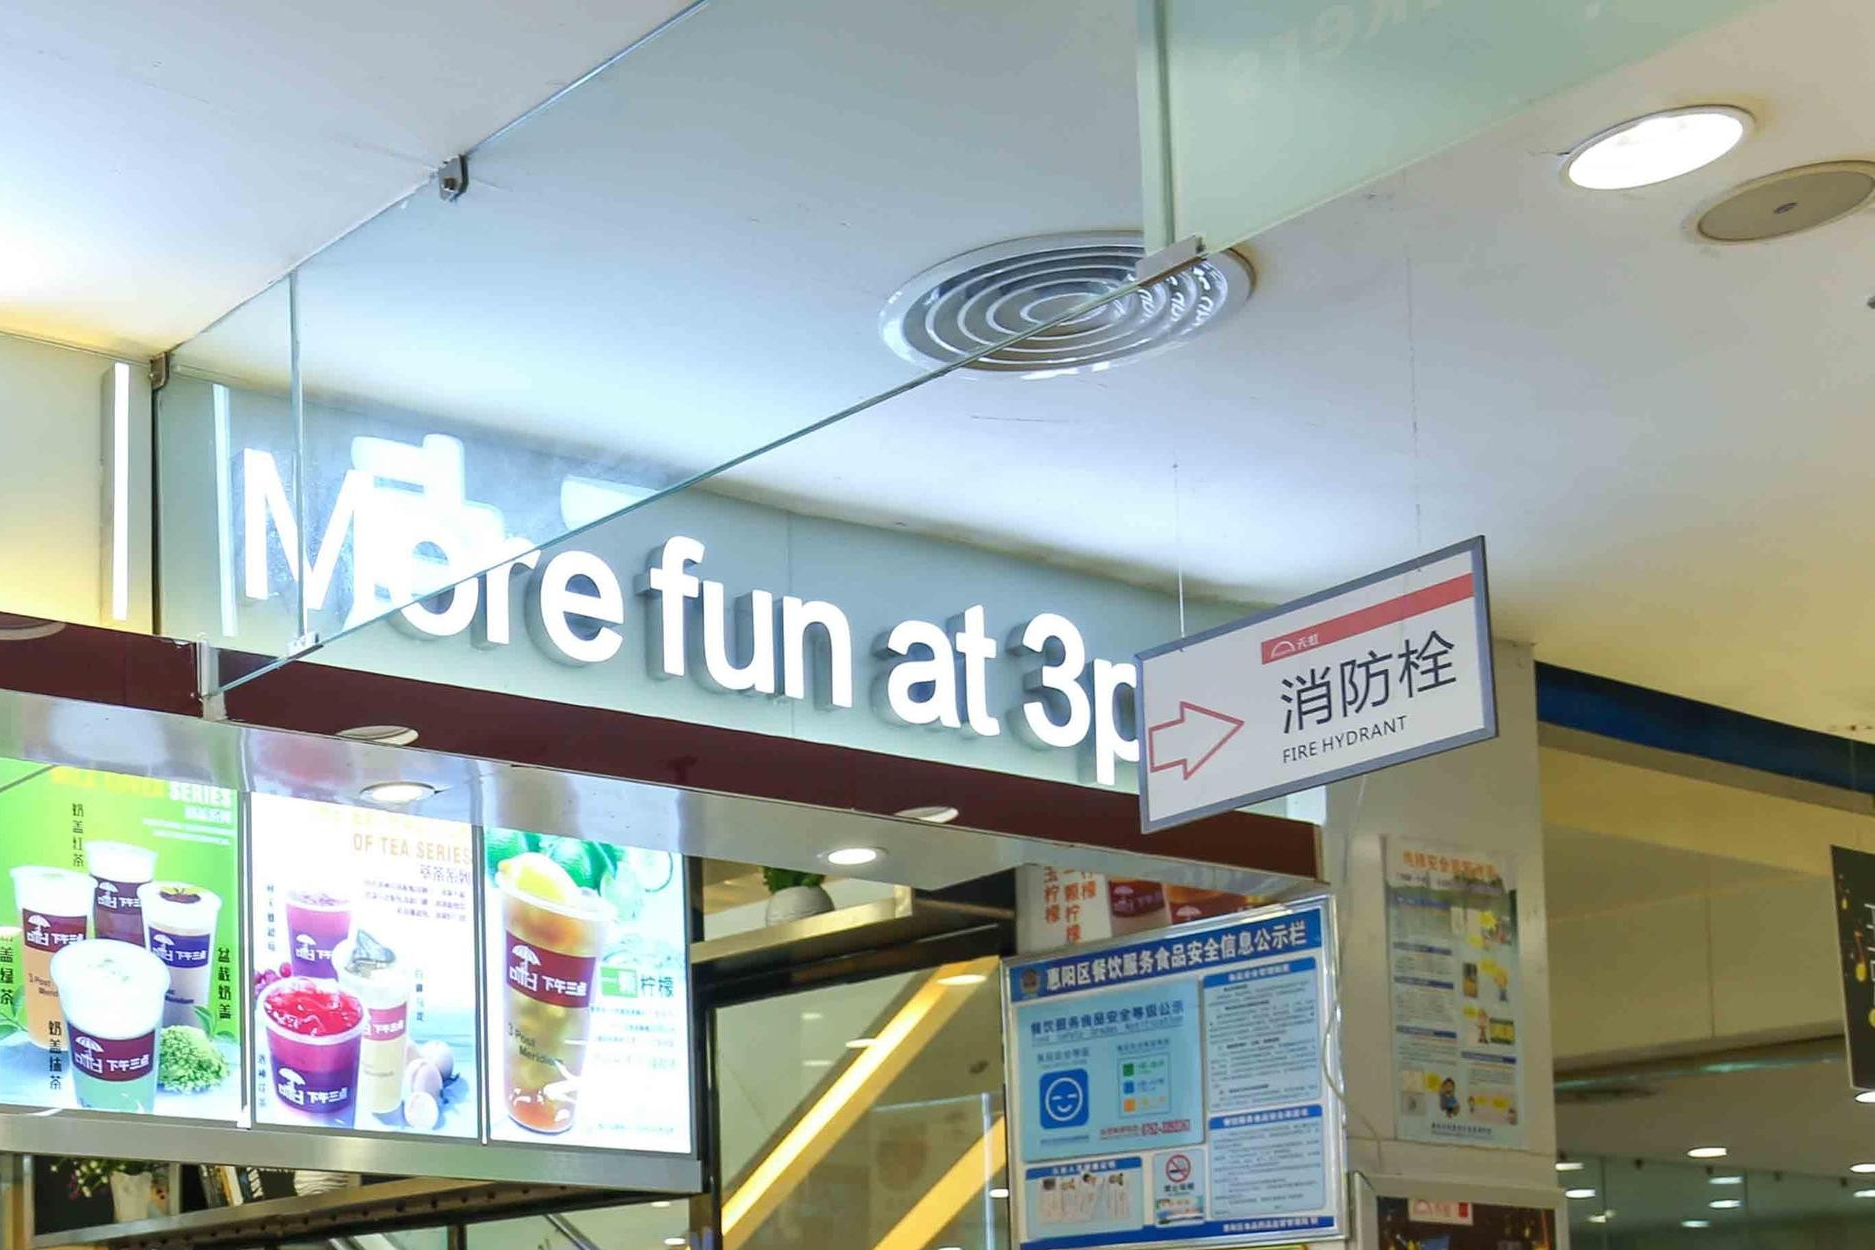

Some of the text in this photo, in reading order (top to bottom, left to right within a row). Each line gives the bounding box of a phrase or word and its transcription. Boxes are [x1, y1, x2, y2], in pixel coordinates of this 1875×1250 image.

[241, 446, 625, 665] More
[651, 535, 854, 708] fun
[883, 603, 1002, 738] at
[1280, 629, 1457, 735] 消防栓
[1282, 714, 1408, 764] FIRE HYDRANT
[353, 832, 473, 866] OF TEA SERIES
[1046, 920, 1308, 991] 惠阳区餐饮服务食品安全信息公示栏
[541, 974, 588, 997] 下午三点
[106, 1053, 150, 1073] 下午三点
[306, 1088, 348, 1105] 下午三点
